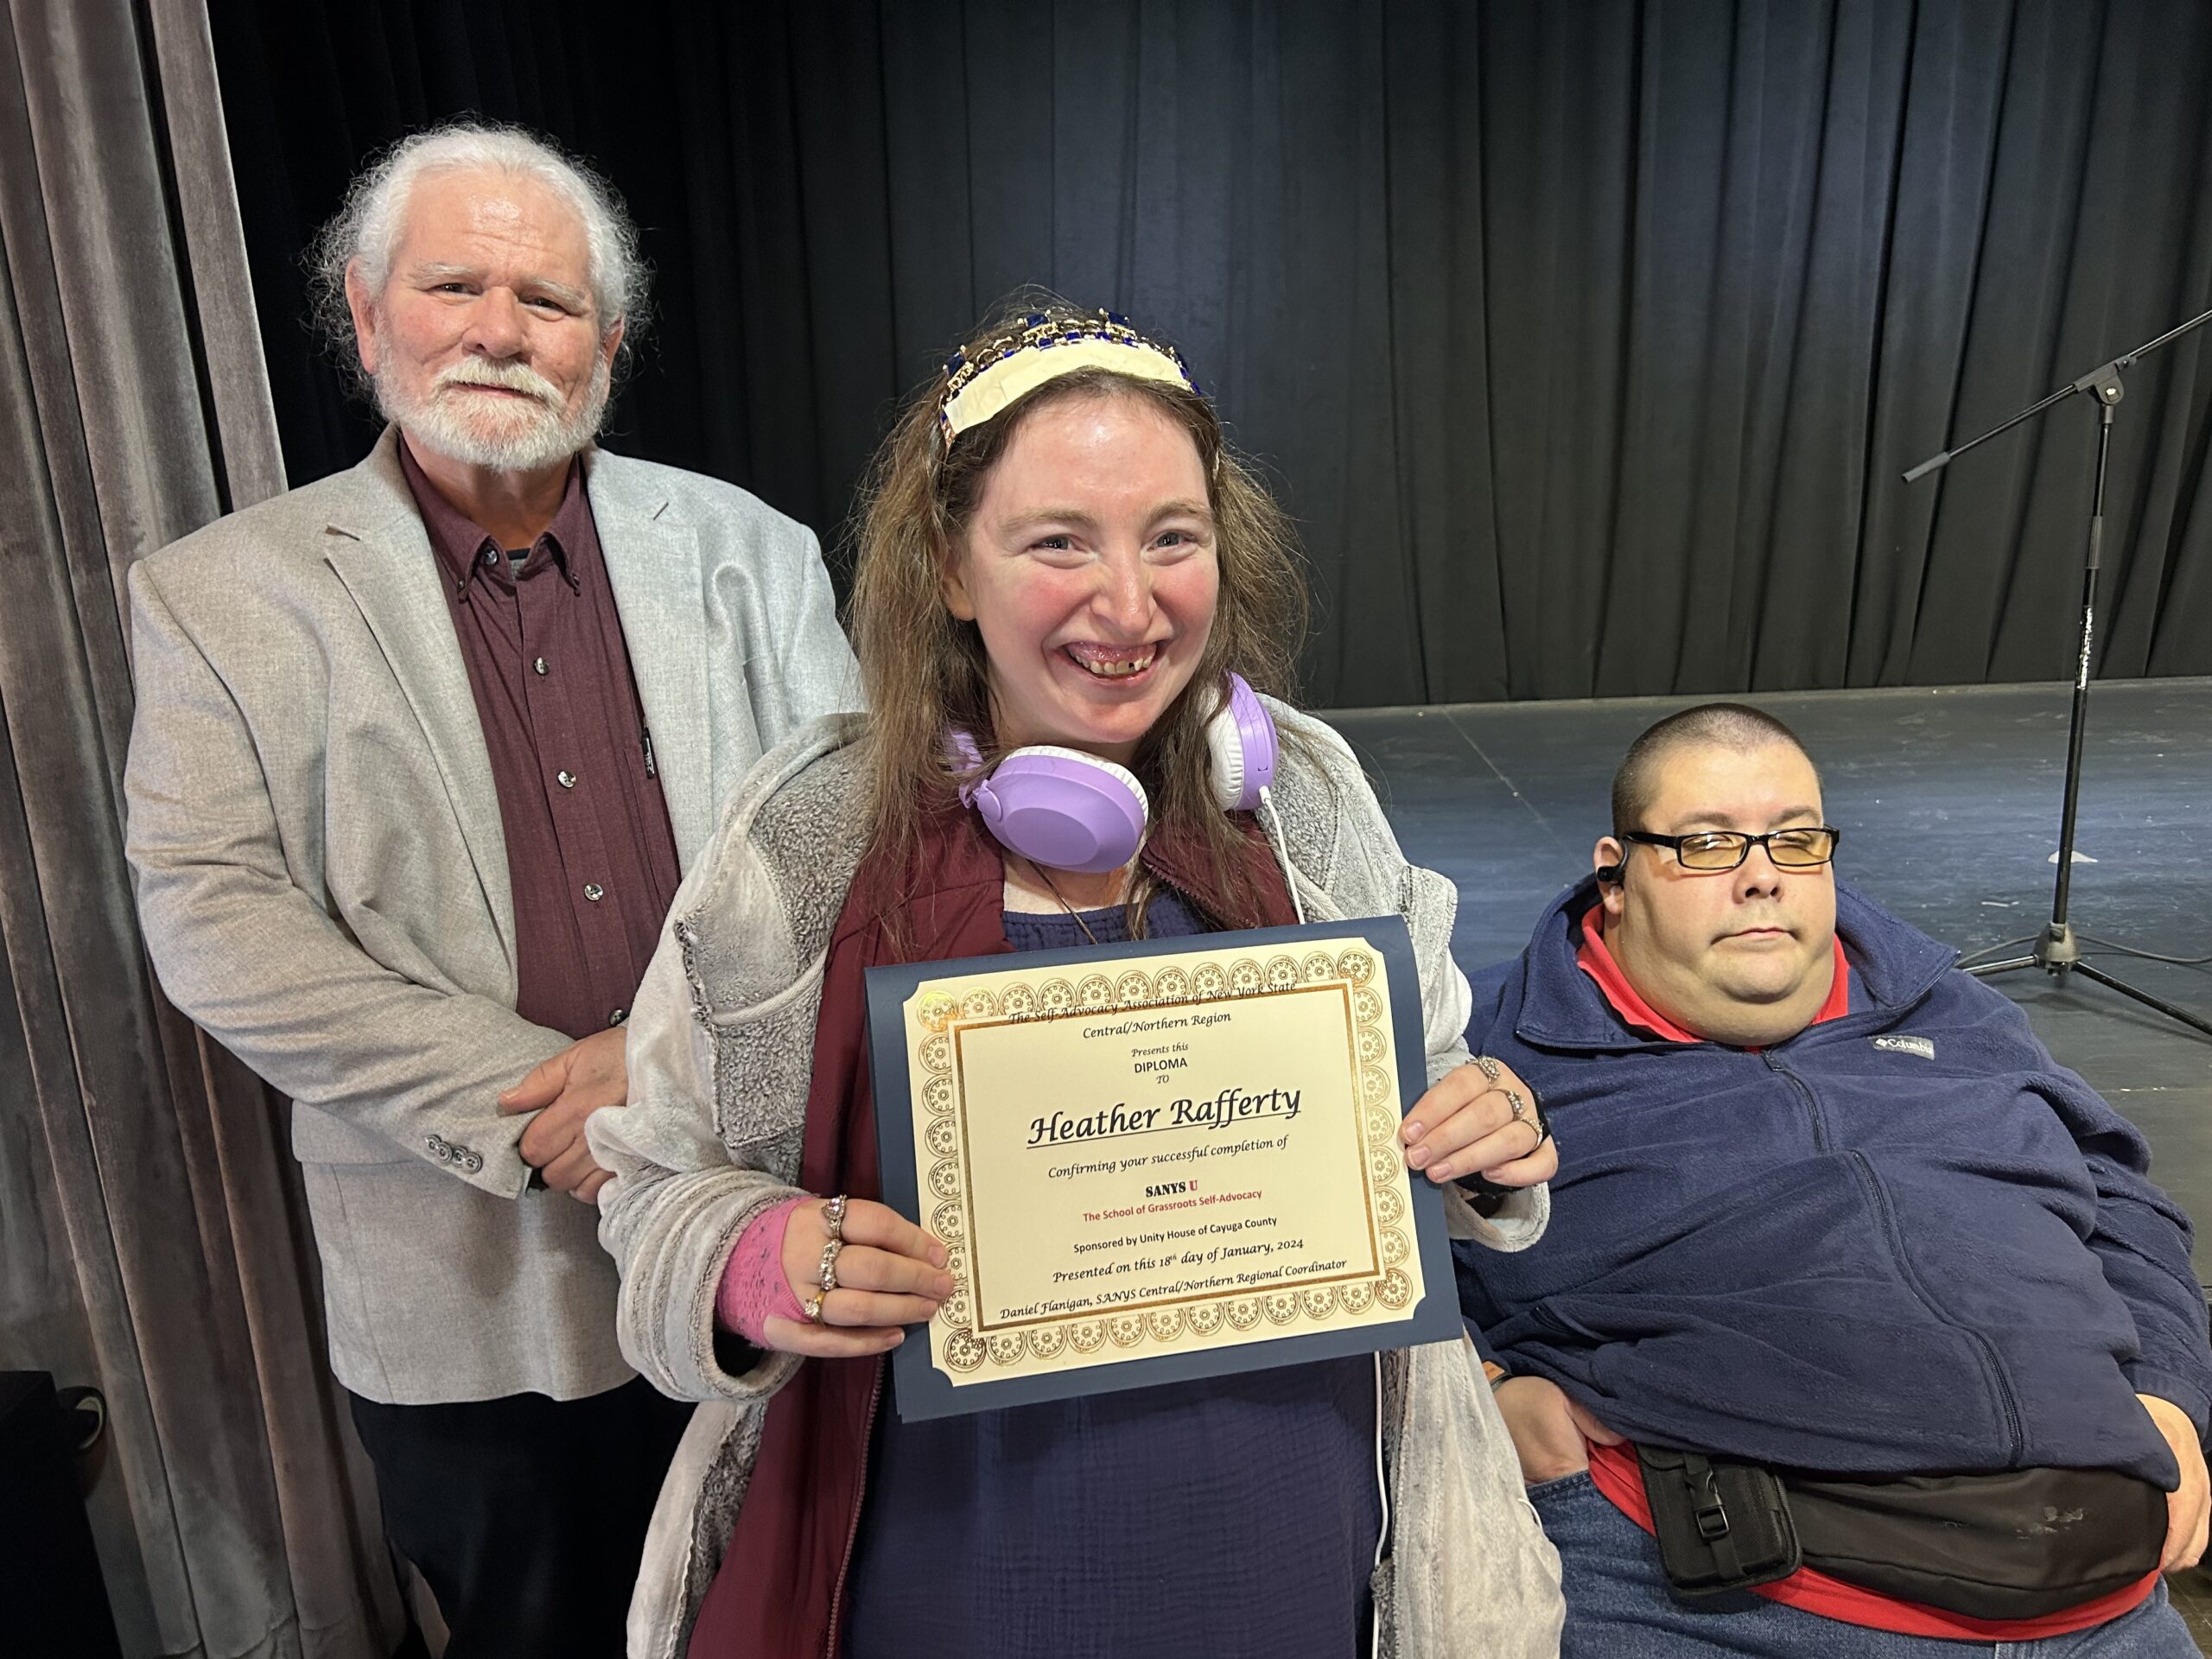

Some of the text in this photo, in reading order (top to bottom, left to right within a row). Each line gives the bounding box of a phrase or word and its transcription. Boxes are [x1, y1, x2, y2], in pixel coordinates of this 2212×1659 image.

[1008, 982, 1296, 1025] The Self-Advocacy Association of New York State
[1083, 1012, 1231, 1039] Central/Northern Region
[1131, 1042, 1189, 1057] Presents this
[1887, 1039, 1934, 1055] Columbia
[1135, 1058, 1188, 1073] DIPLOMA
[1156, 1074, 1170, 1084] TO
[1027, 1088, 1301, 1145] Heather Rafferty
[1048, 1135, 1289, 1179] Confirming your successful completion of
[1083, 1189, 1262, 1222] The School of Grassroots Self-Advocacy
[1146, 1180, 1198, 1198] SANYS U
[1074, 1217, 1277, 1254] Sponsored by Unity House of Cayuga County
[1052, 1262, 1114, 1282] Presented
[1116, 1262, 1131, 1273] on
[1135, 1257, 1155, 1271] this
[1181, 1251, 1203, 1265] day
[1206, 1247, 1219, 1262] of
[1220, 1243, 1274, 1260] January,
[1277, 1239, 1303, 1249] 2024
[1000, 1259, 1347, 1319] Daniel Flanigan, SANYS Central/Northern Regional Coordinator
